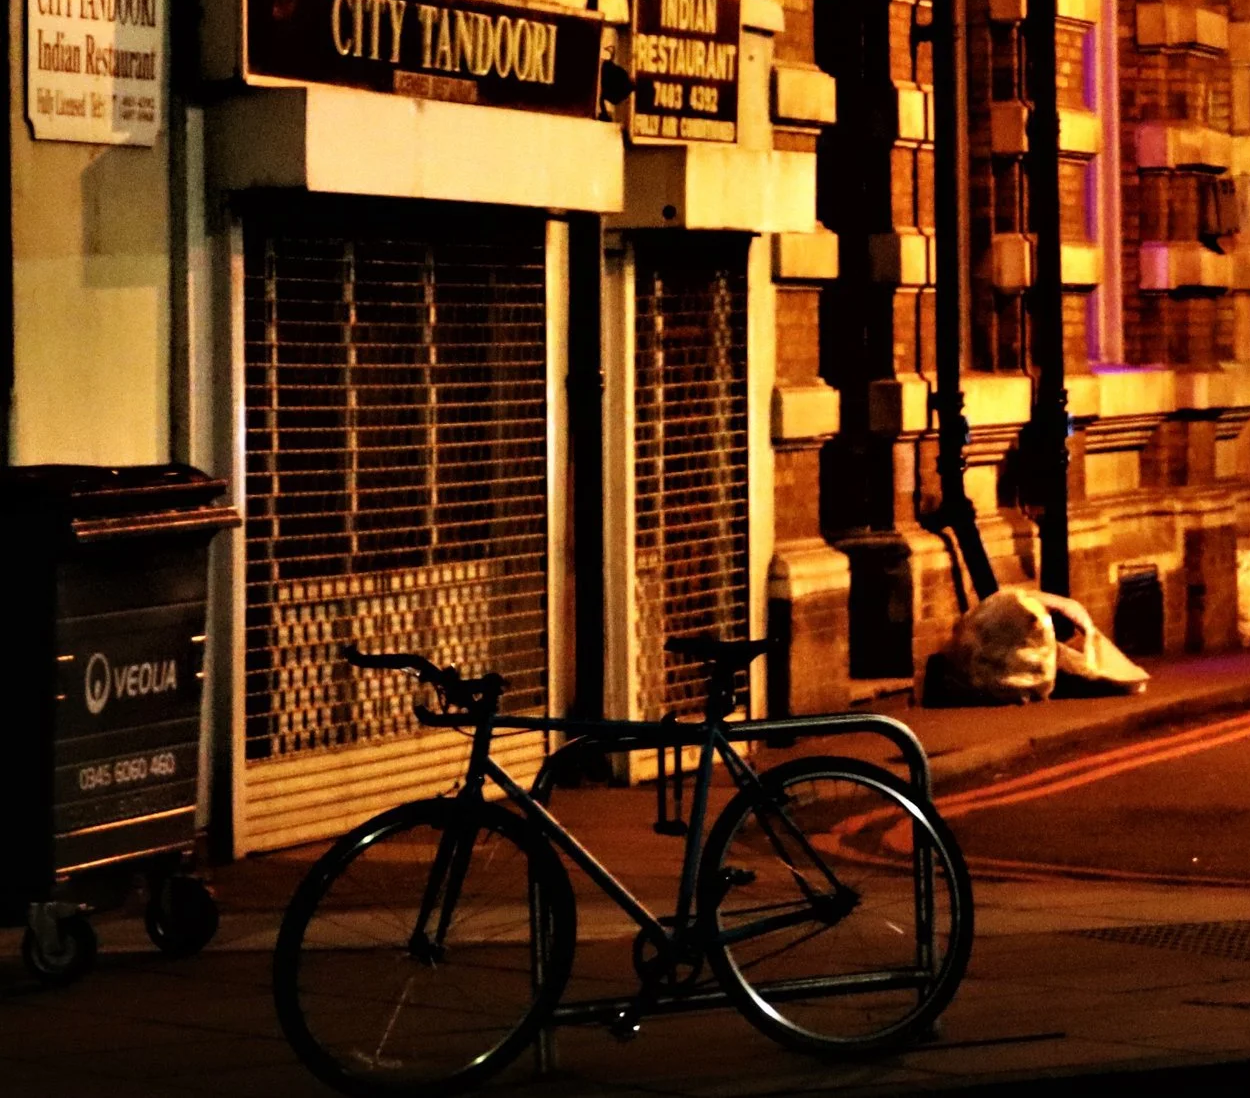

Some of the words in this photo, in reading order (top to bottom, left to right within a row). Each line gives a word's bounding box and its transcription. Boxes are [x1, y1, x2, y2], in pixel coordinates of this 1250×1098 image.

[37, 29, 82, 74] Indian
[85, 34, 156, 80] Restaurant
[415, 3, 558, 85] TANDOORI
[634, 33, 737, 81] RESTAURANT
[113, 659, 178, 699] VEOLIA
